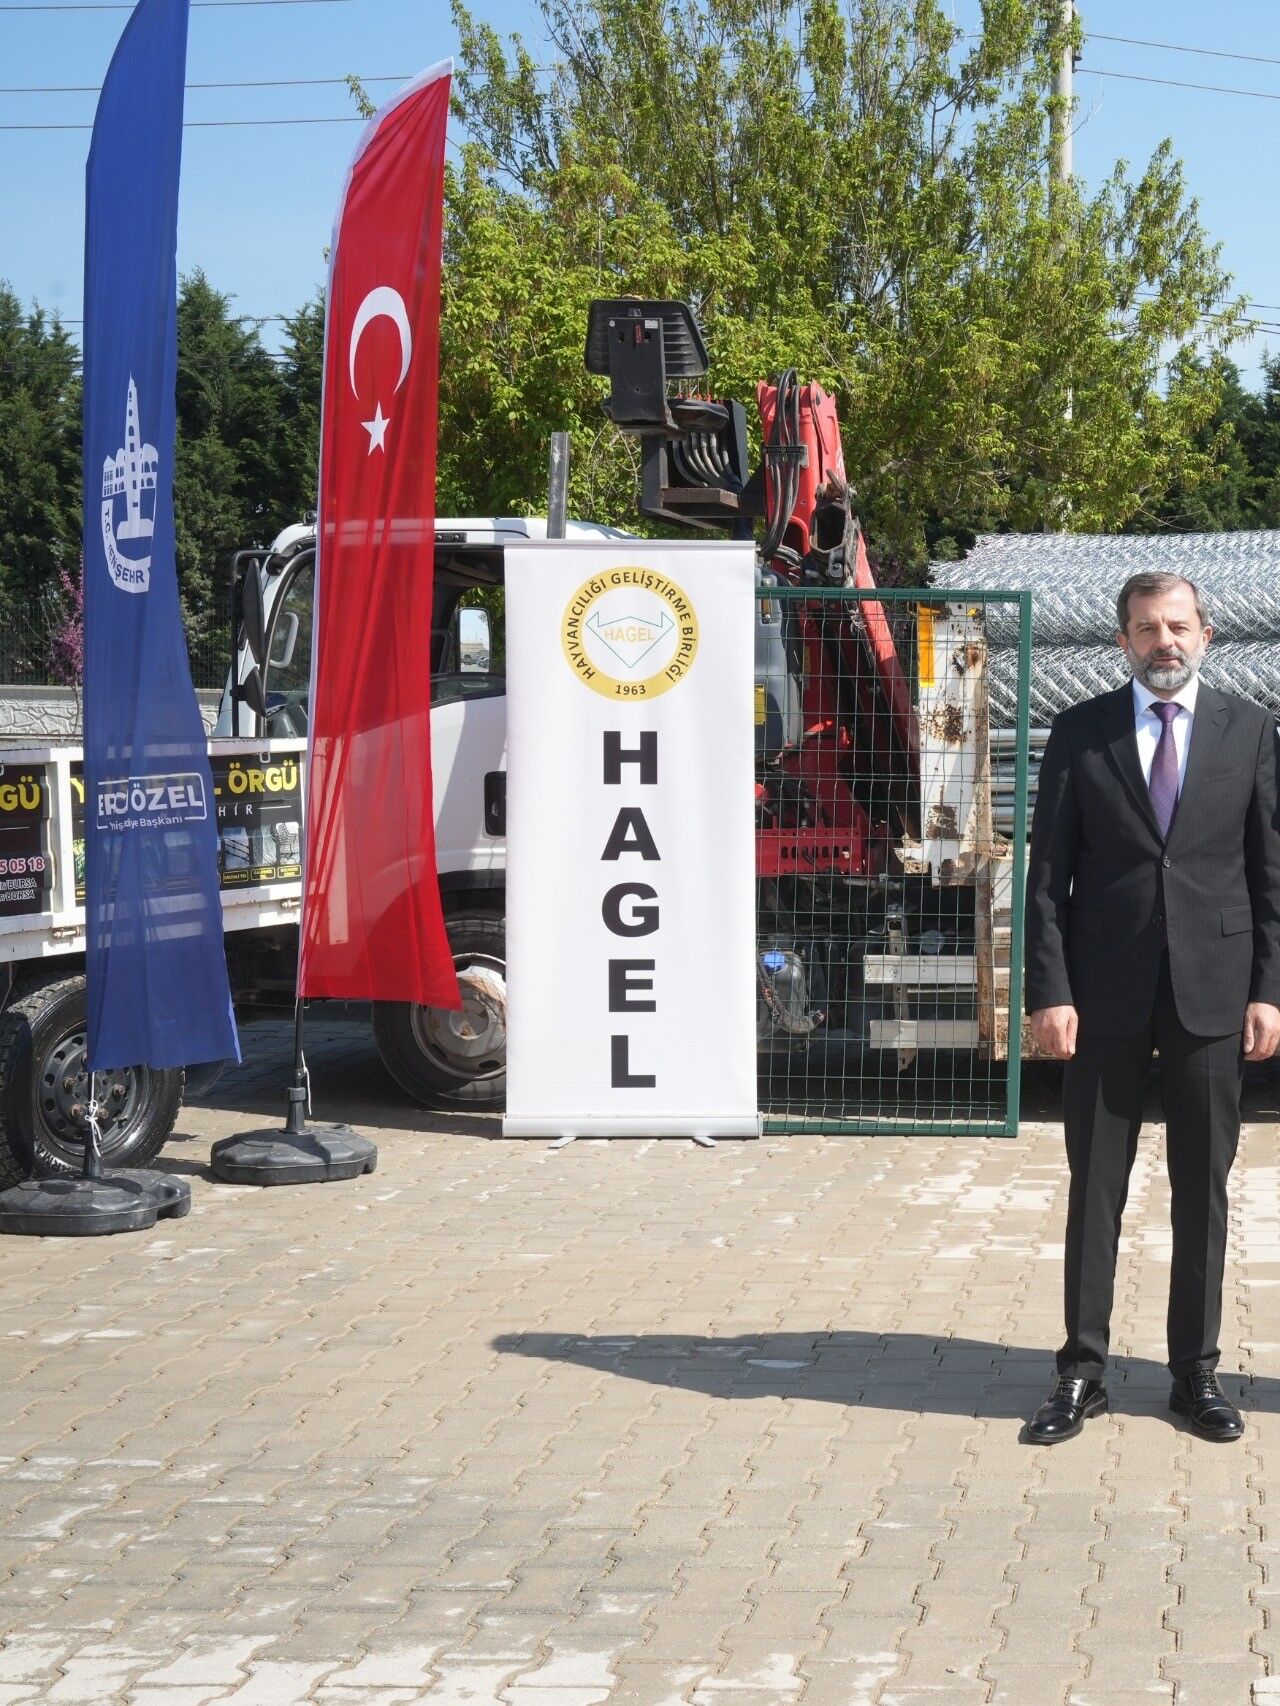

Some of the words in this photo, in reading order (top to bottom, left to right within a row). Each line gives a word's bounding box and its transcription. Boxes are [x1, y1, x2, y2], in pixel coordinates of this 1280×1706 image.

[567, 578, 607, 680] HAYVANCILIĞI
[611, 570, 691, 622] GELİŞTİRME
[665, 626, 696, 683] BİRLİĞİ
[604, 626, 656, 642] HAGEL
[615, 684, 646, 695] 1963
[0, 775, 40, 811] GÜ
[228, 760, 297, 794] ÖRGÜ
[131, 783, 203, 812] ÖZEL
[600, 731, 661, 1088] HAGEL
